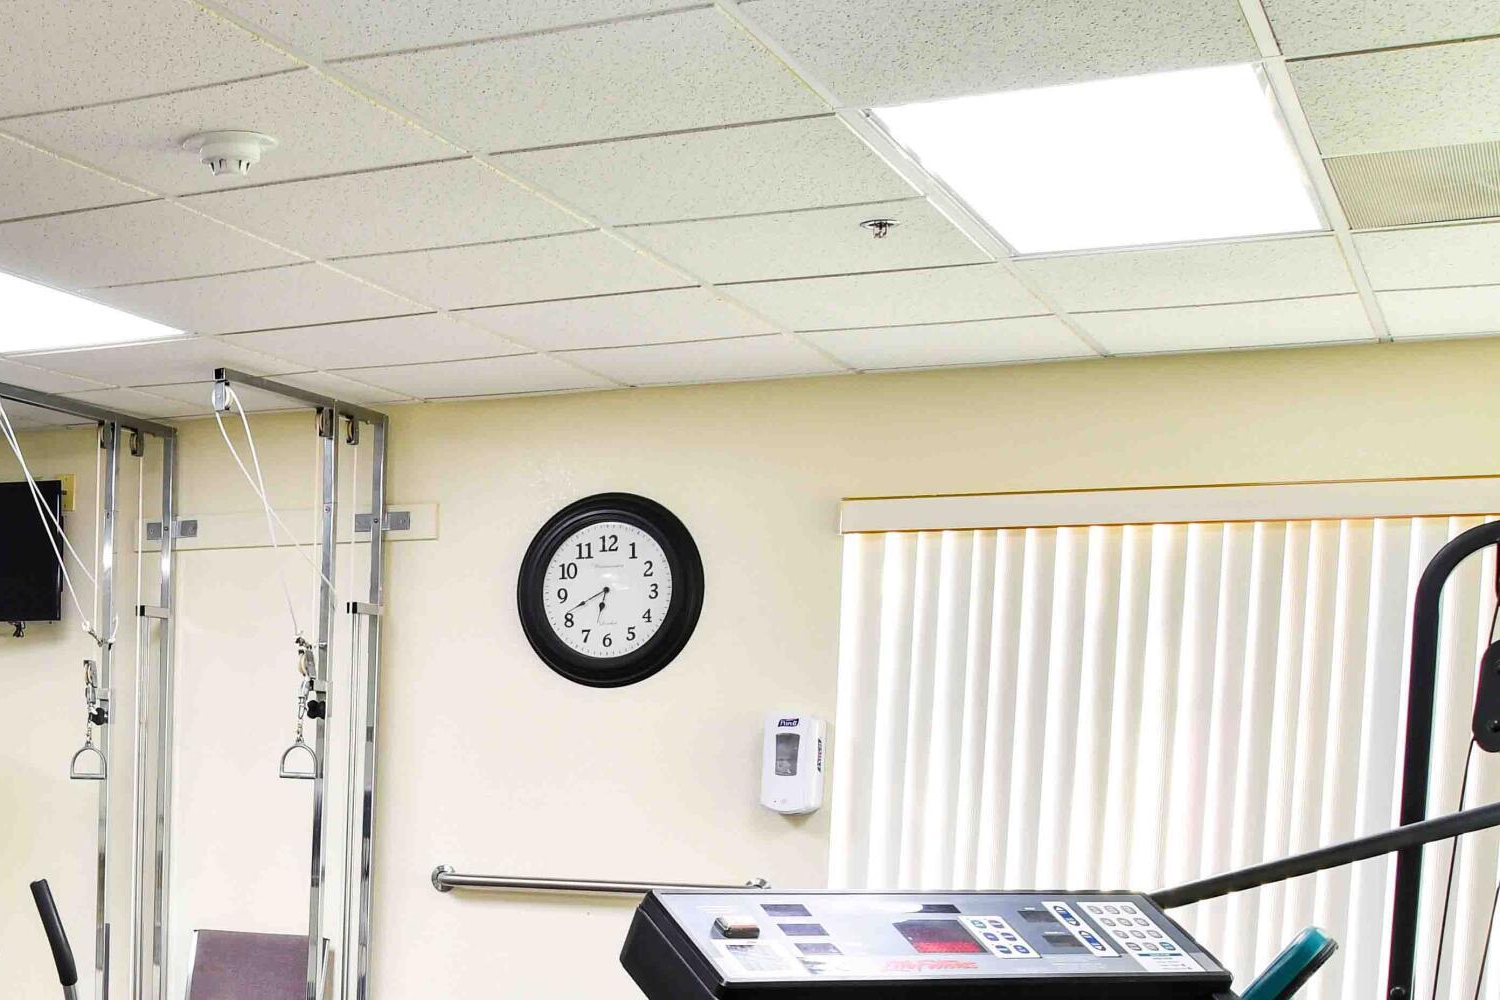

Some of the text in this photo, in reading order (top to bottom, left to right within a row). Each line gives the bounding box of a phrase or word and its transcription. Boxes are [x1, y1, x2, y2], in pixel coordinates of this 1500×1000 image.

[575, 542, 594, 560] 11
[599, 534, 619, 552] 12
[629, 542, 638, 559] 1
[559, 562, 578, 580] 10
[643, 560, 653, 577] 2
[557, 588, 568, 604] 9
[648, 583, 659, 600] 3
[564, 612, 574, 628] 8
[642, 608, 652, 623] 4
[581, 629, 591, 643] 7
[602, 633, 612, 647] 6
[626, 626, 636, 641] 5
